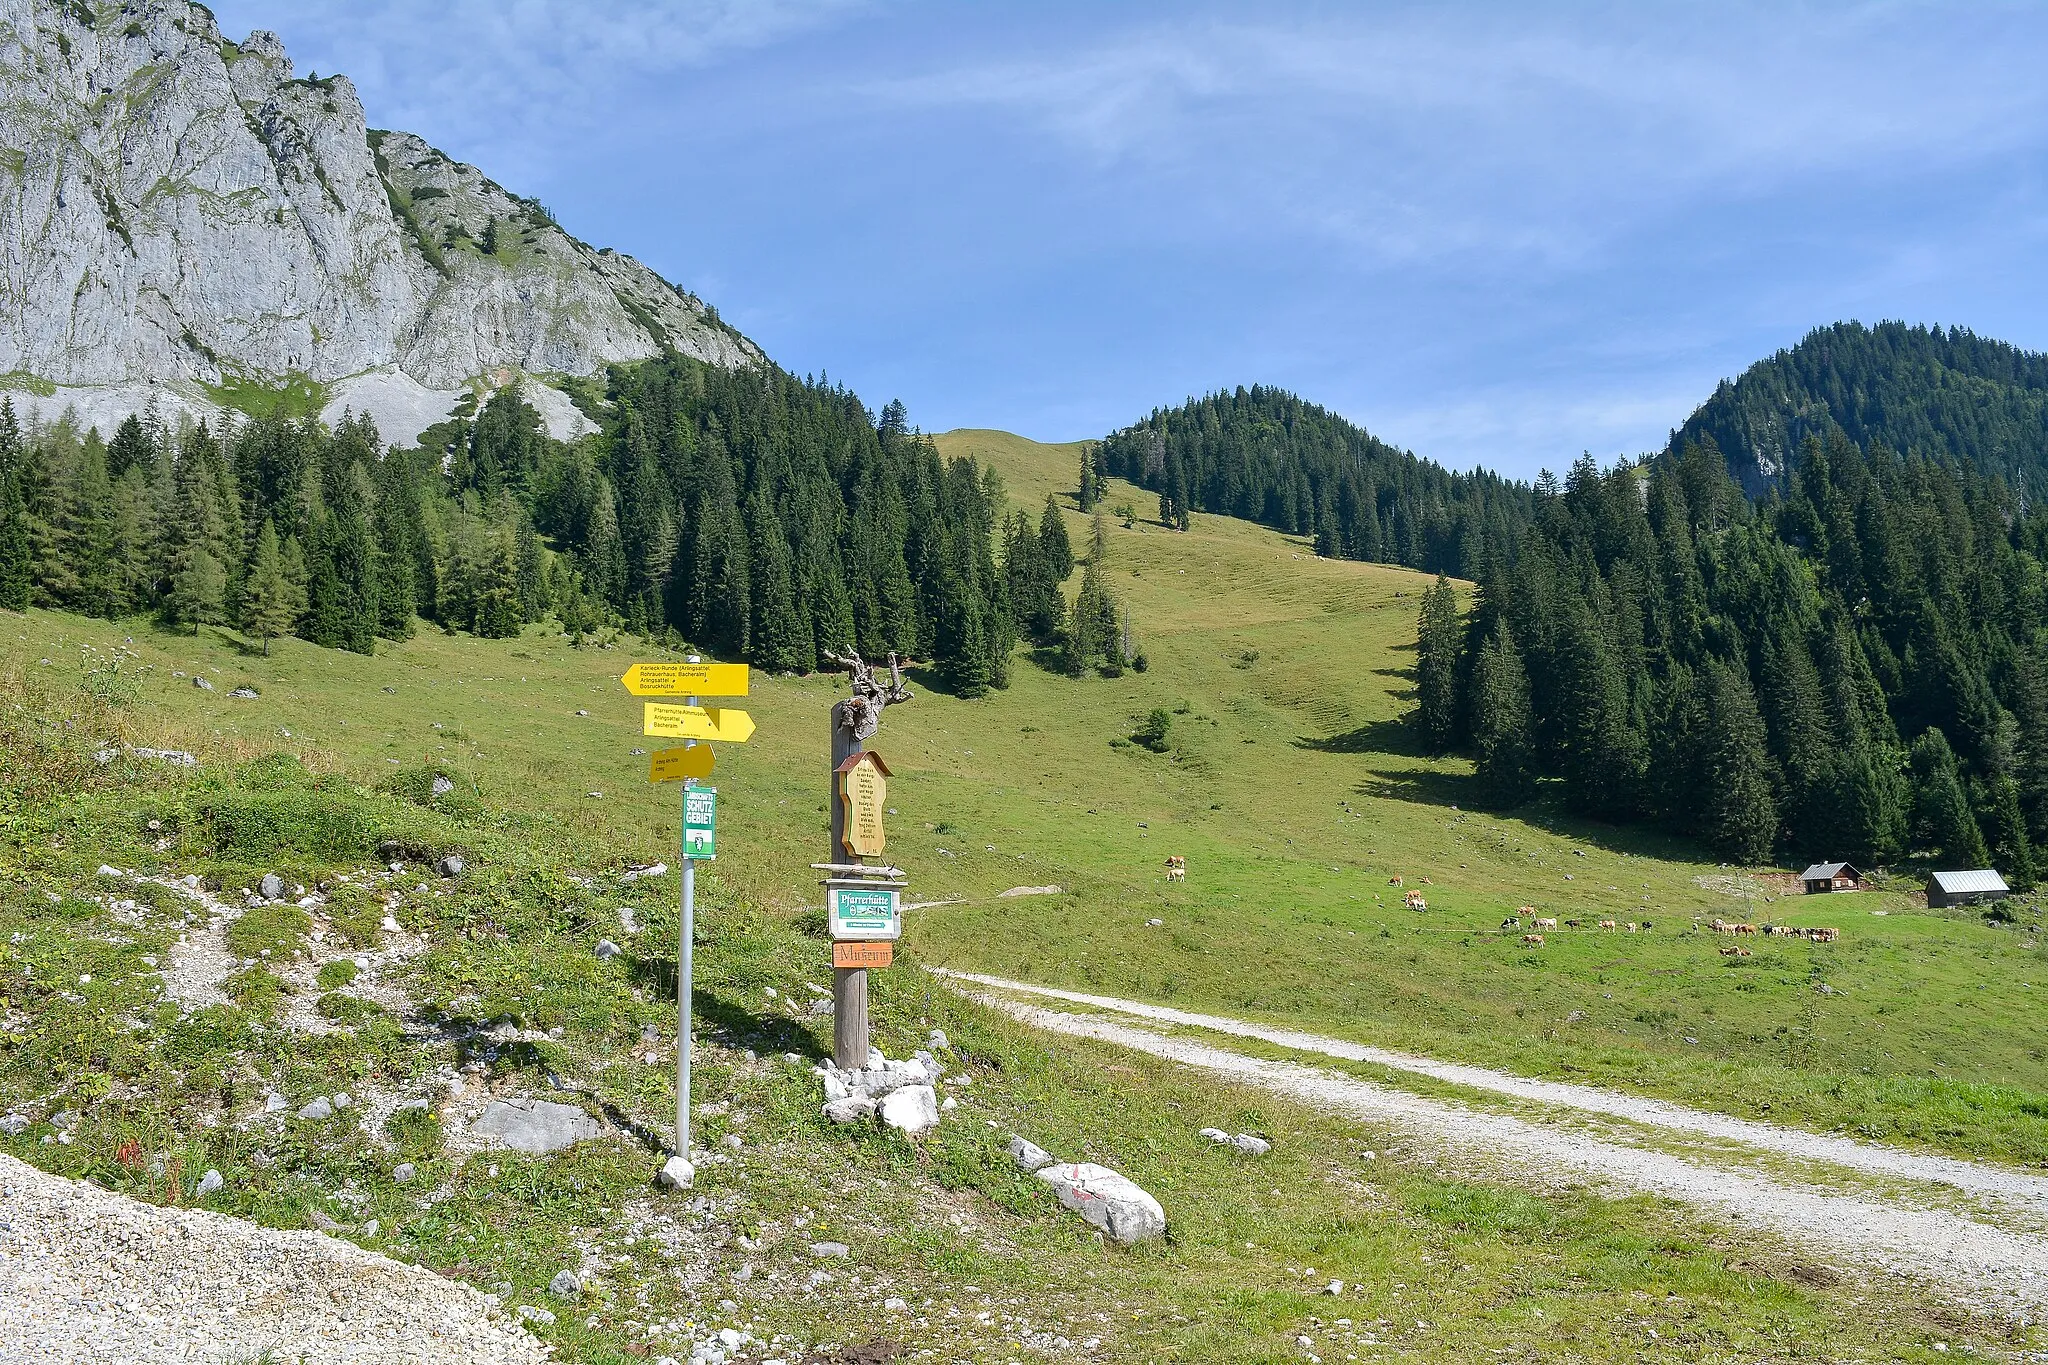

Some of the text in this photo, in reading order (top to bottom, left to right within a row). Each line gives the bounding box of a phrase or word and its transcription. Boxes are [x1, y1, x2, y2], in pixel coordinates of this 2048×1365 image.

[686, 799, 713, 812] SCHUTZ
[686, 811, 713, 825] GEBIET
[840, 893, 889, 907] Pfarrerhütte
[840, 945, 889, 961] Museum
